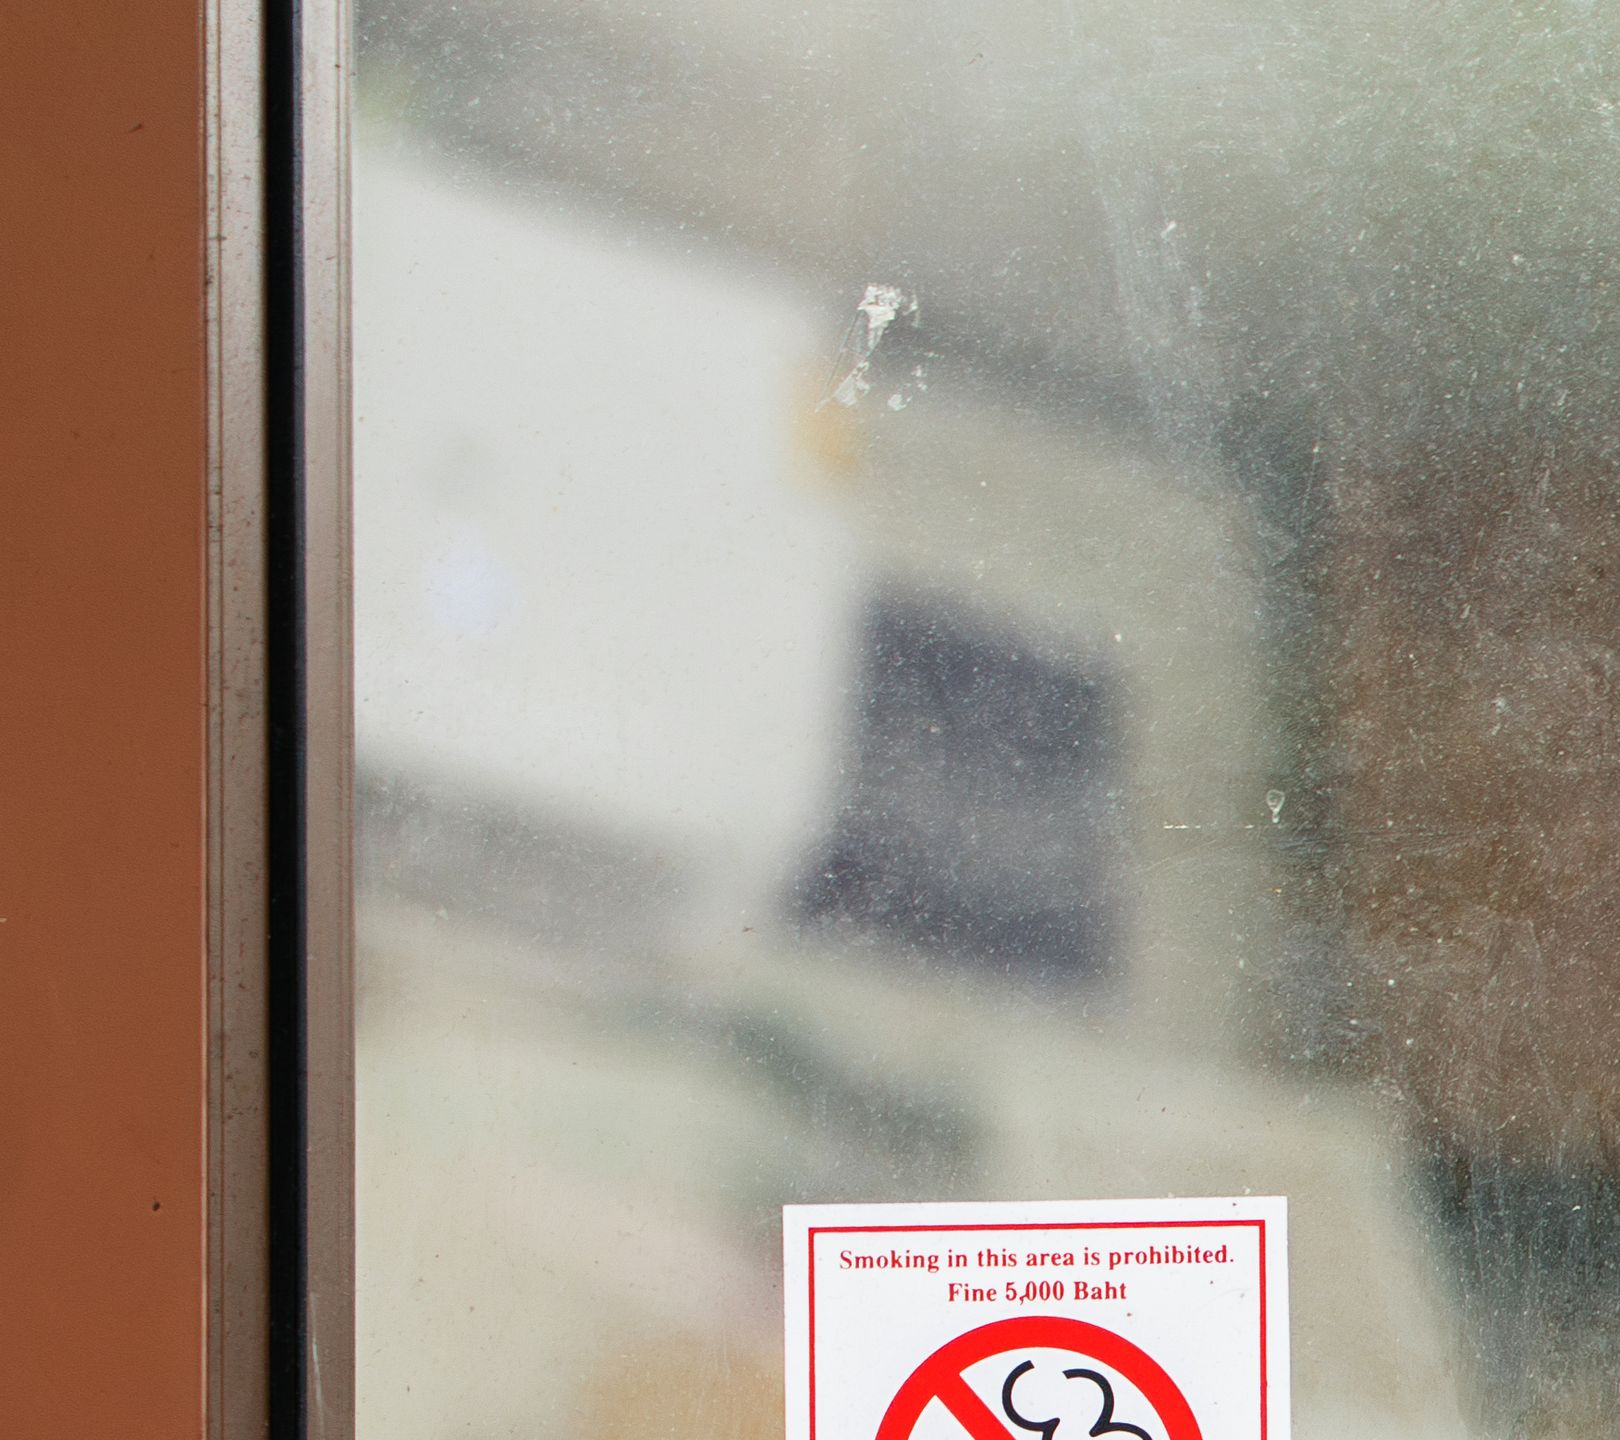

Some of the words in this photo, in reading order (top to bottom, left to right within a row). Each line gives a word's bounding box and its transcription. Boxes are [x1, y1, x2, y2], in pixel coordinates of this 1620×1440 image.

[839, 1249, 940, 1273] Smoking
[947, 1248, 968, 1269] in
[977, 1247, 1018, 1268] this
[1025, 1252, 1075, 1267] area
[1083, 1247, 1101, 1266] is
[1108, 1243, 1234, 1271] prohibited.
[948, 1282, 998, 1302] Fine
[1004, 1280, 1065, 1305] 5,000
[1073, 1280, 1127, 1301] Baht
